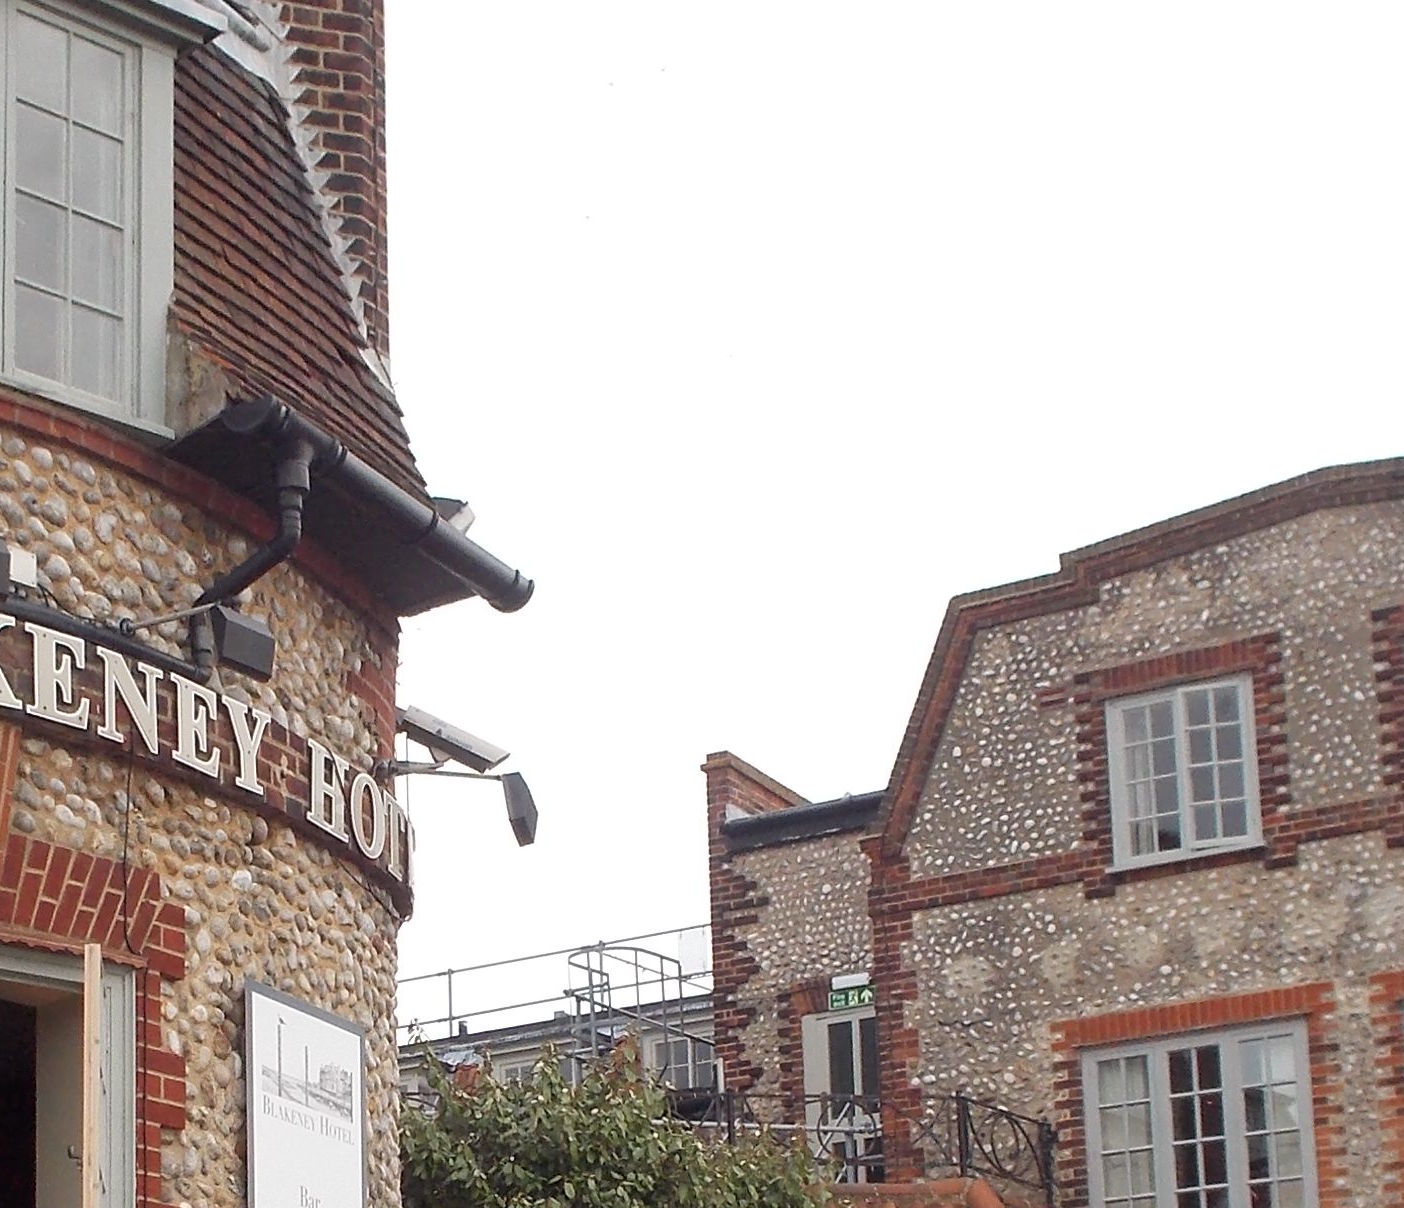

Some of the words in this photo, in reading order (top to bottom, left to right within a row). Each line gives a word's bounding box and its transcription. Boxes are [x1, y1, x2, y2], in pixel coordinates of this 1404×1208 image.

[306, 738, 414, 884] HOT
[262, 1094, 315, 1132] BLAKENEY
[320, 1115, 355, 1146] HOTEL
